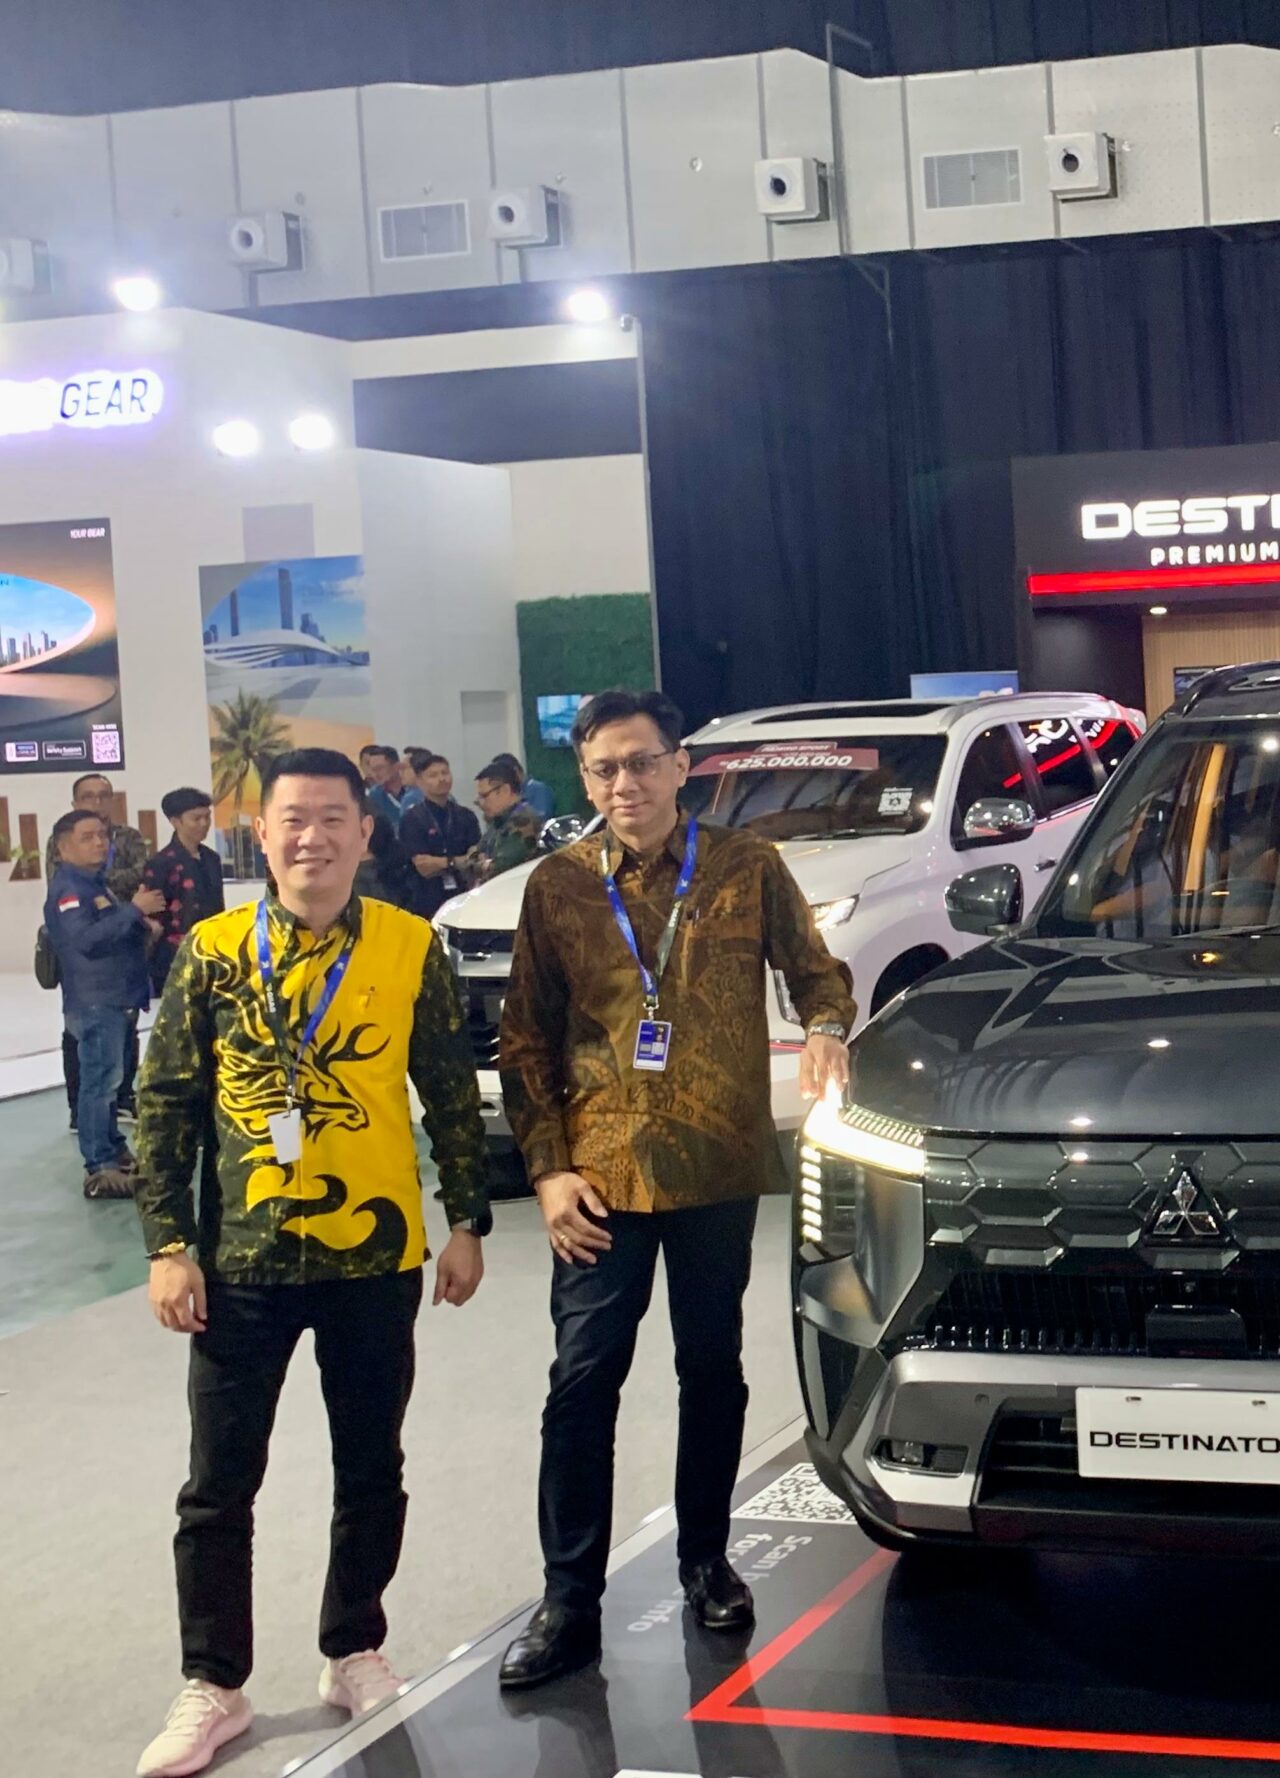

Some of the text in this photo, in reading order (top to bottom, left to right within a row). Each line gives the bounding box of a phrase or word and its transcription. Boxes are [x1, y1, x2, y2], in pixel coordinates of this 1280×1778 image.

[60, 378, 150, 419] GEAR
[1150, 541, 1280, 566] PREMIUM
[751, 1534, 814, 1569] Scan
[627, 1599, 689, 1632] info
